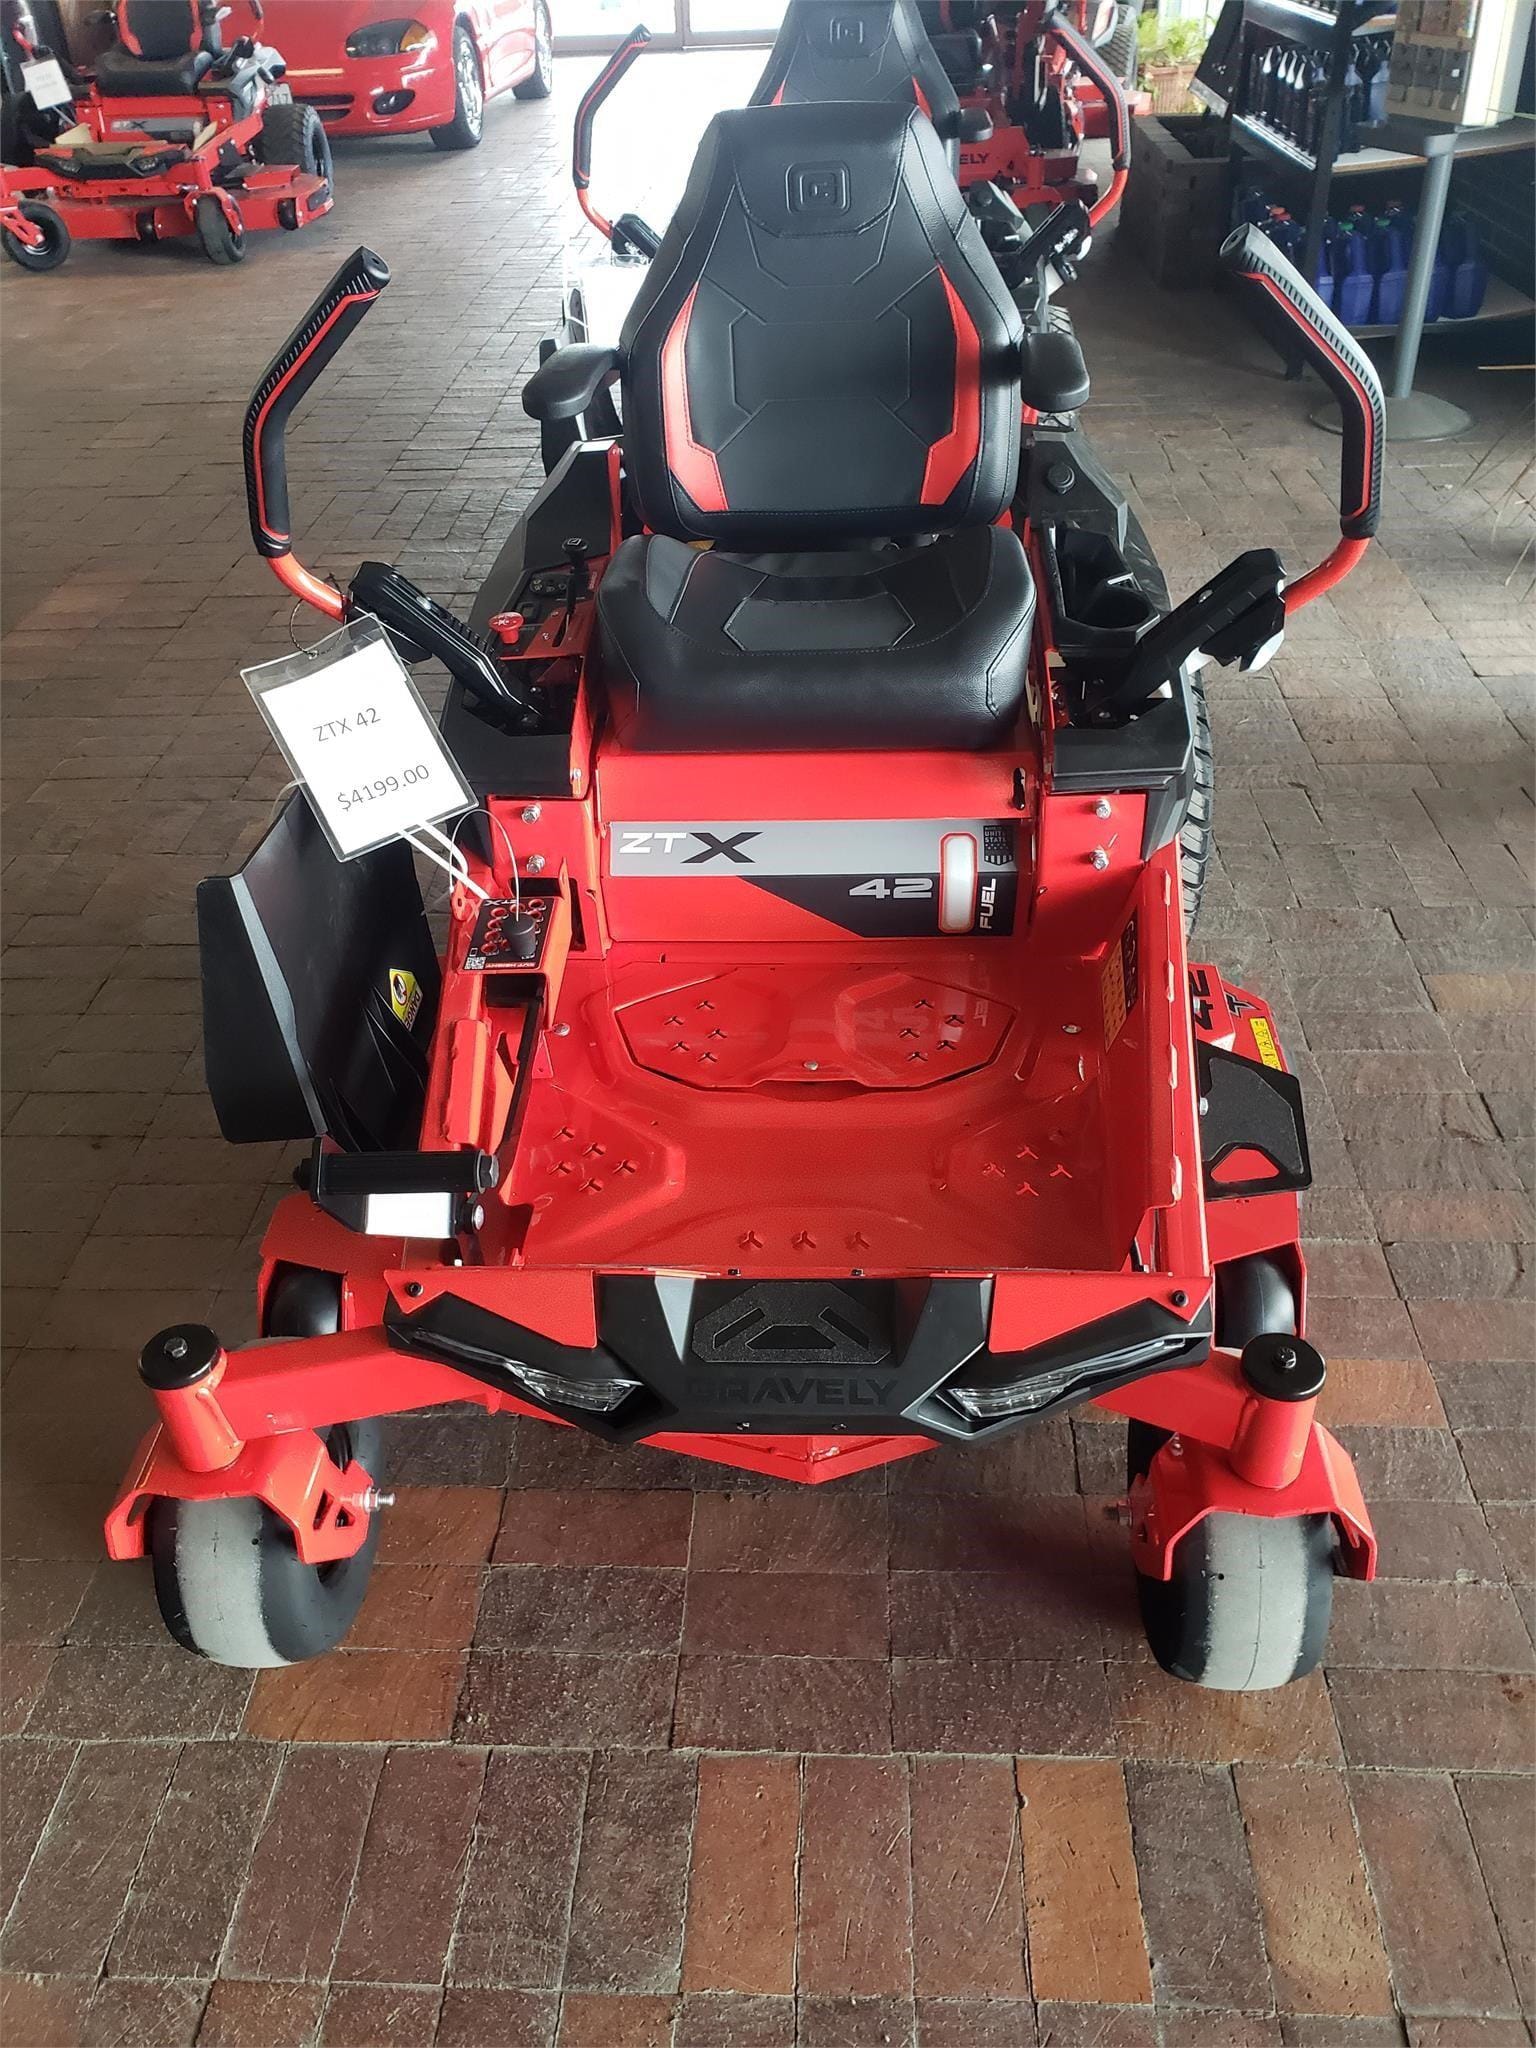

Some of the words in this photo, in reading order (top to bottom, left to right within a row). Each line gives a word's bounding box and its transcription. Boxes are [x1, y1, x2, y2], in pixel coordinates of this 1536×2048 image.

[313, 718, 352, 741] ZTX
[357, 708, 381, 726] 42
[338, 765, 429, 811] $4199.00
[849, 878, 933, 899] 42
[980, 878, 997, 929] FUEL
[685, 1377, 898, 1405] GRAVELY
